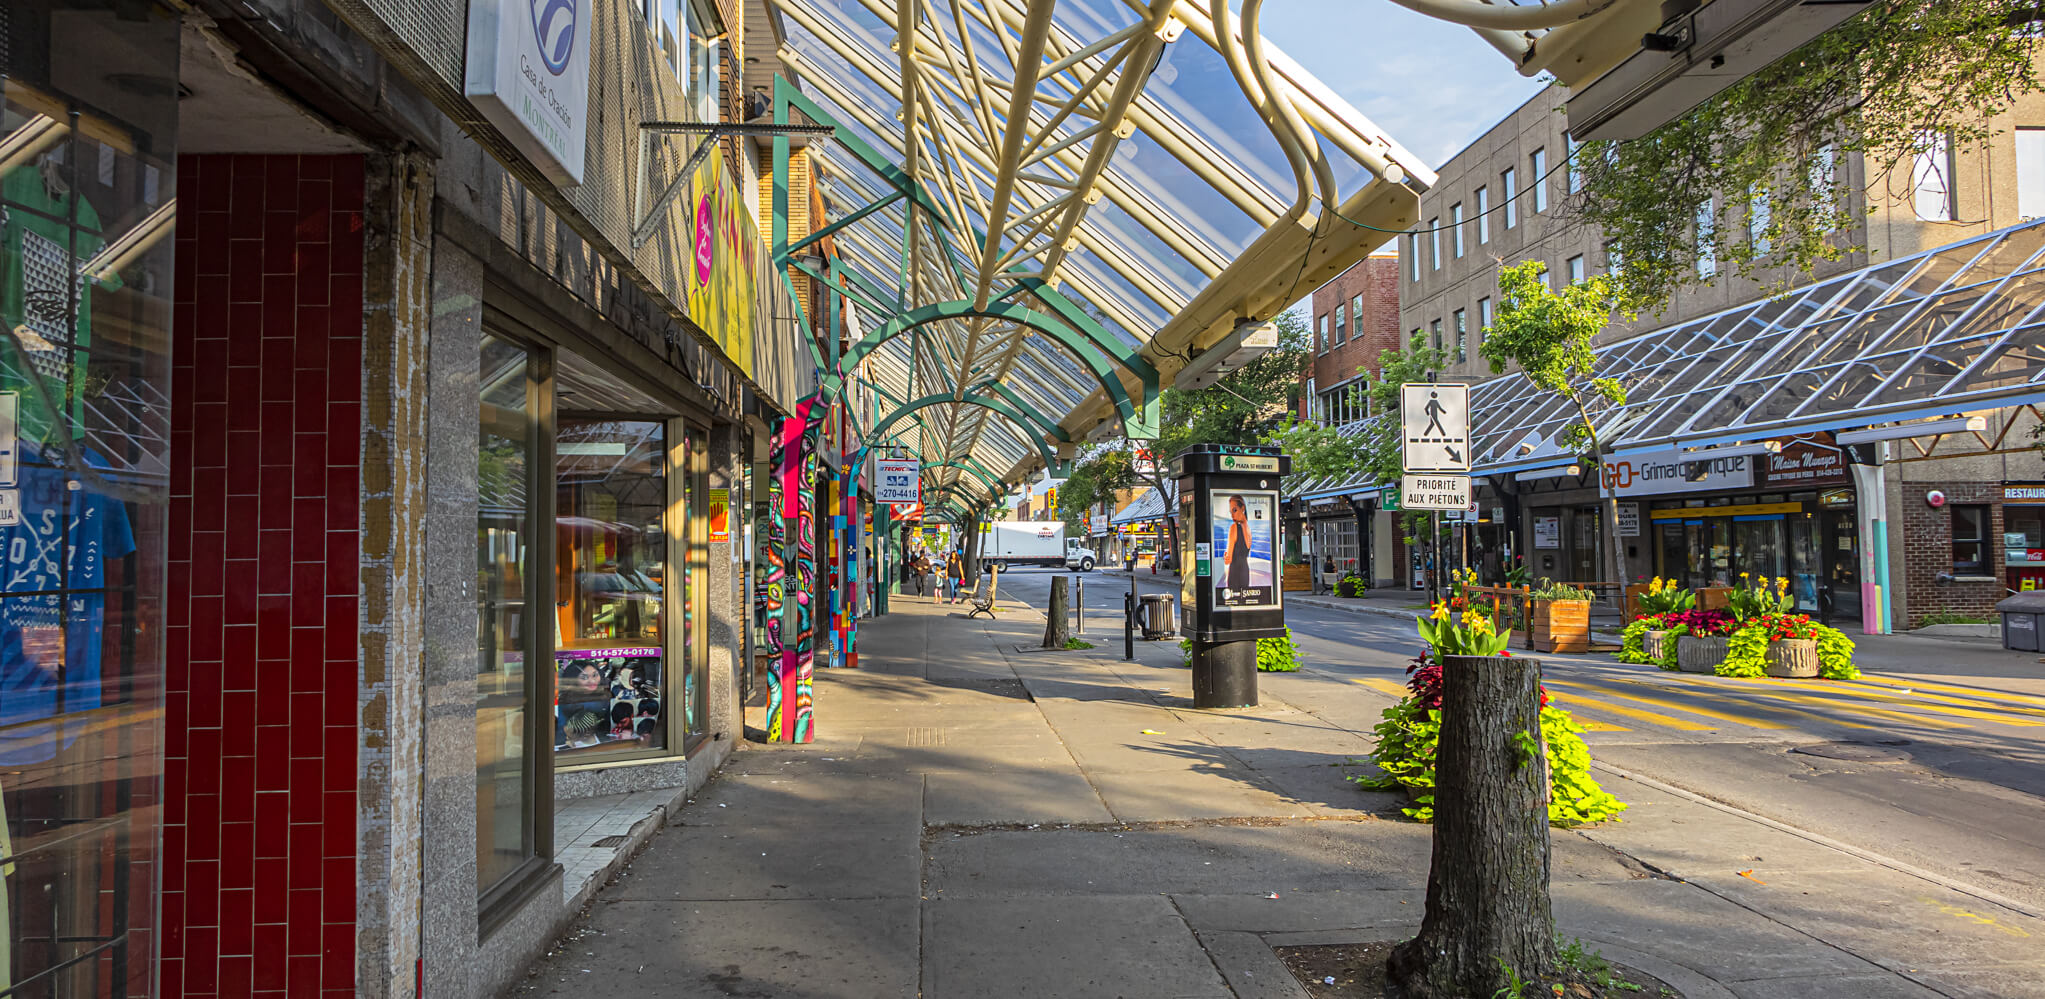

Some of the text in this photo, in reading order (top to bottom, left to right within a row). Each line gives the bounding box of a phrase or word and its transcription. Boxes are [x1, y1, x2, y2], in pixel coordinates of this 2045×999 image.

[520, 54, 572, 129] Casa de Oración
[1773, 455, 1801, 470] Maison
[1417, 477, 1456, 490] PRIORITÉ
[883, 488, 917, 498] 270-4416
[1408, 490, 1465, 505] AUX PIÉTONS
[590, 648, 655, 657] 514-574-0176
